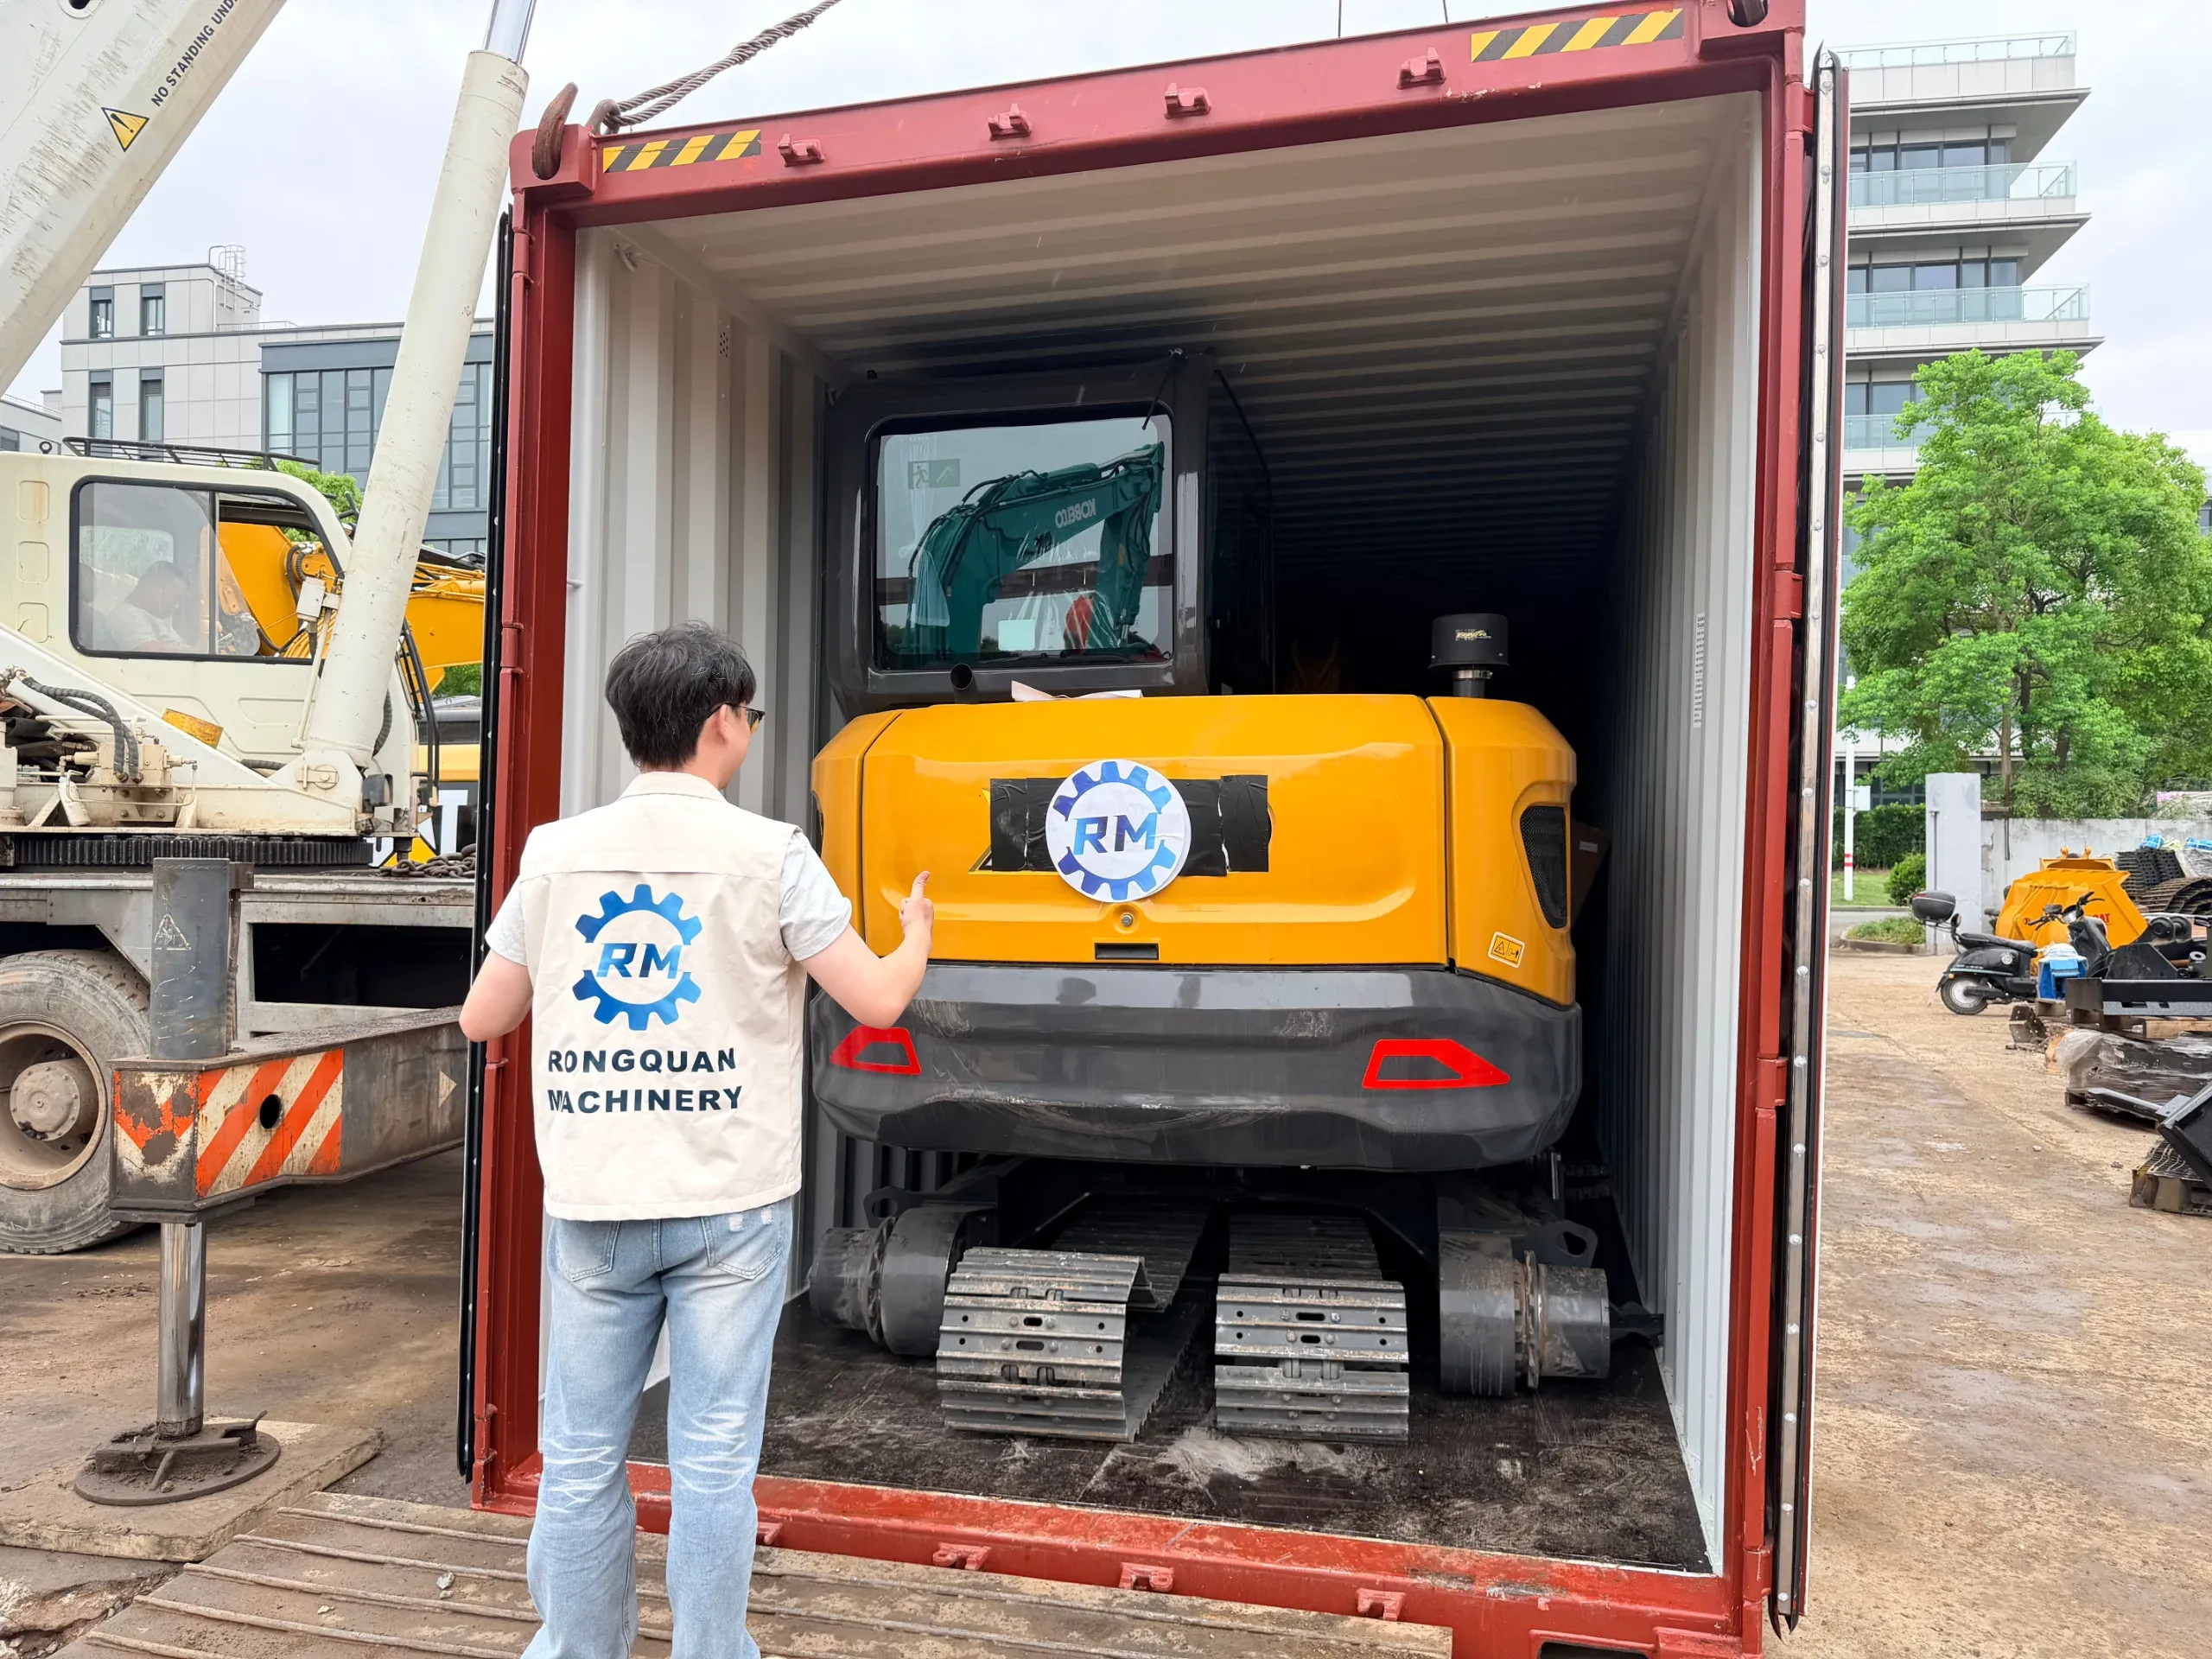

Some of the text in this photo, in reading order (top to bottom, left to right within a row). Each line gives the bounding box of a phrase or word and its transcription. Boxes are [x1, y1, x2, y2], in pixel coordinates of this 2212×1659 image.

[151, 0, 238, 106] NO STANDING UND
[1072, 812, 1158, 855] RM
[595, 942, 683, 980] RM
[547, 1047, 736, 1074] RONGQUAN
[547, 1085, 743, 1114] MACHINERY
